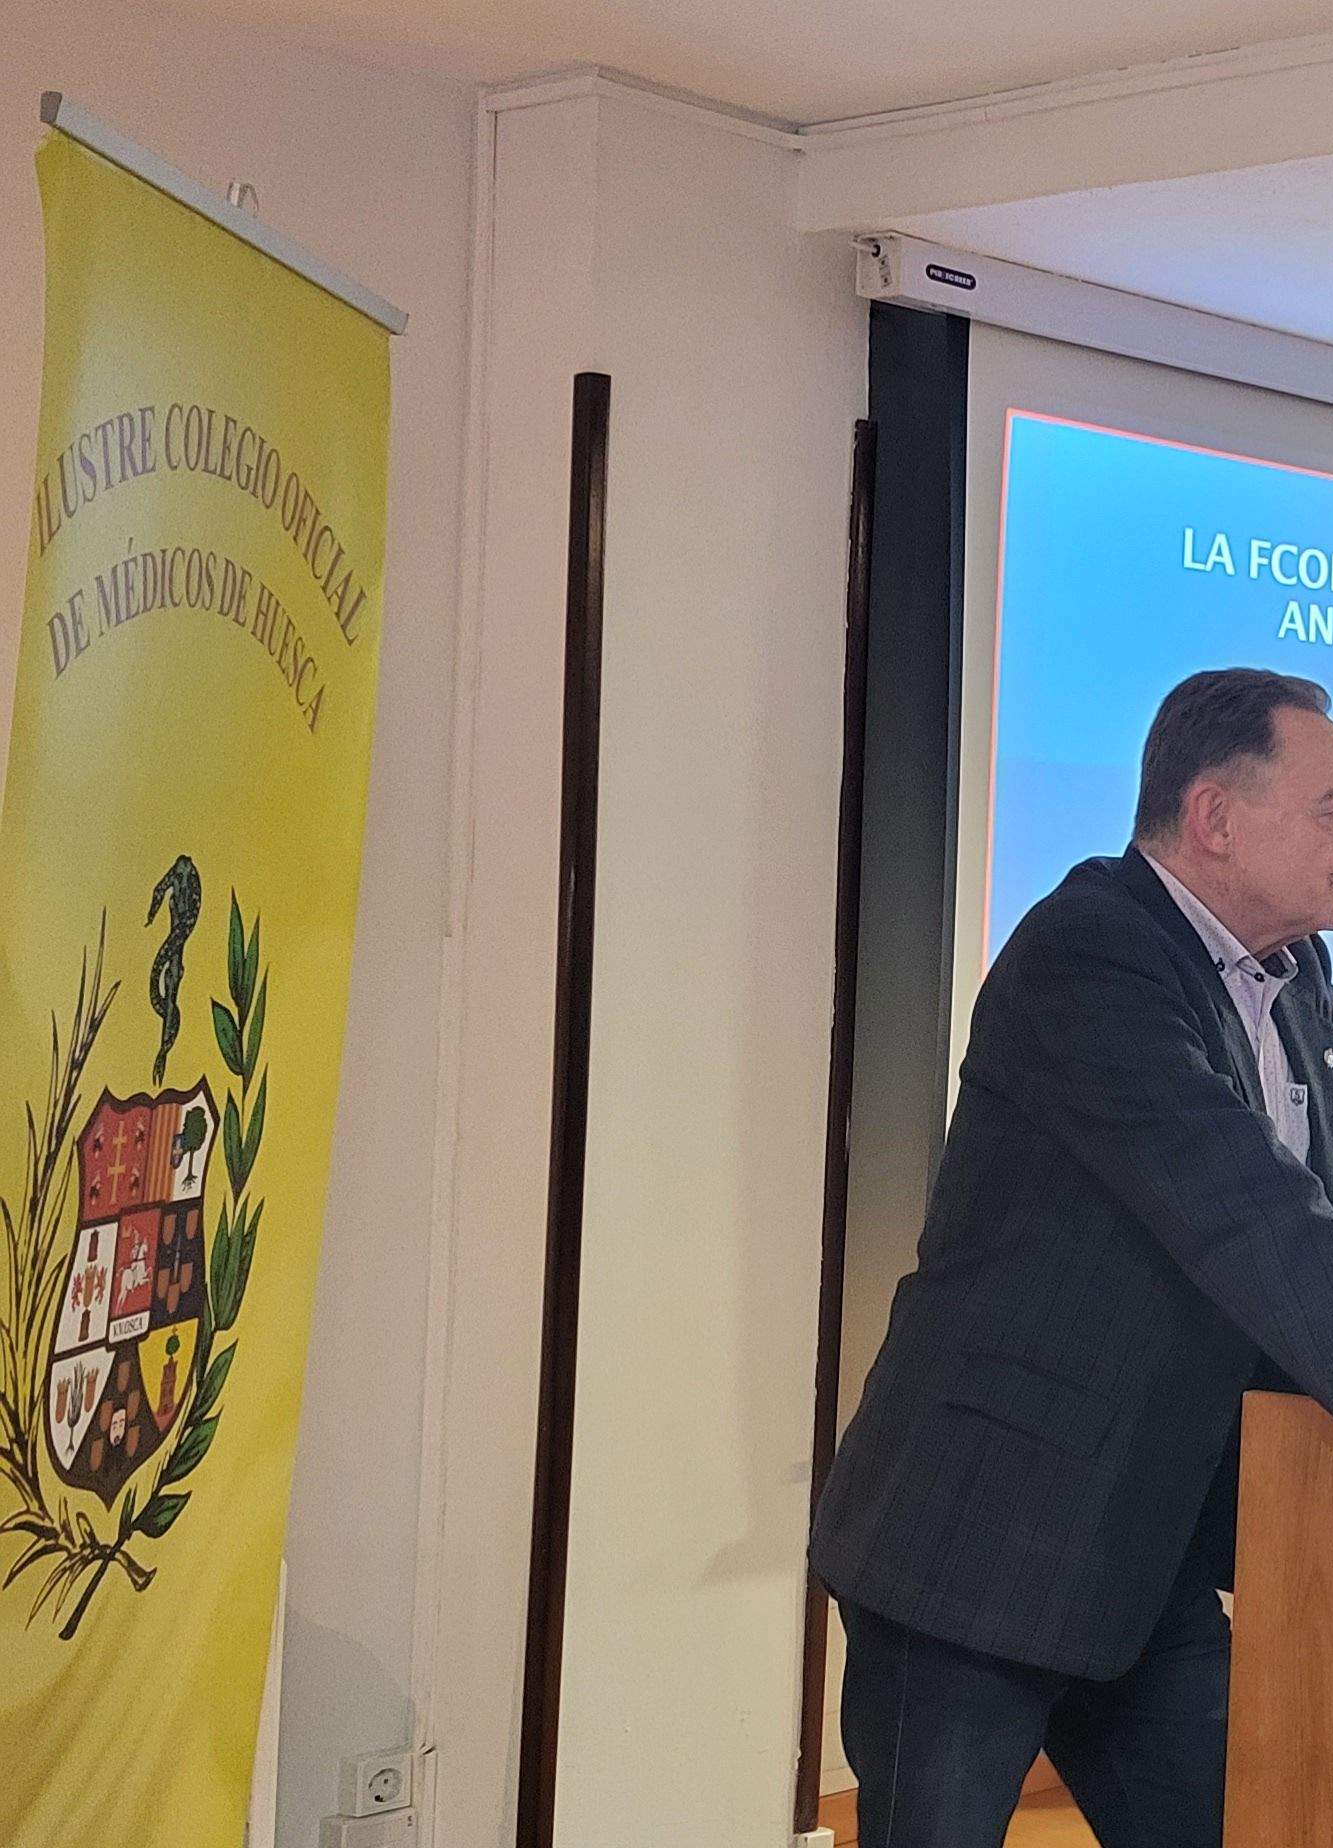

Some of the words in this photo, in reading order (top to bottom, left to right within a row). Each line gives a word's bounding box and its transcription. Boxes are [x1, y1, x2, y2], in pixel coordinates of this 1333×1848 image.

[33, 405, 157, 557] ILUSTRE
[164, 402, 281, 509] COLEGIO
[281, 472, 367, 647] OFICIAL
[1182, 527, 1234, 574] LA
[46, 588, 92, 681] DE
[94, 536, 218, 639] MÉDICOS
[216, 557, 252, 628] DE
[250, 580, 326, 735] HUESCA
